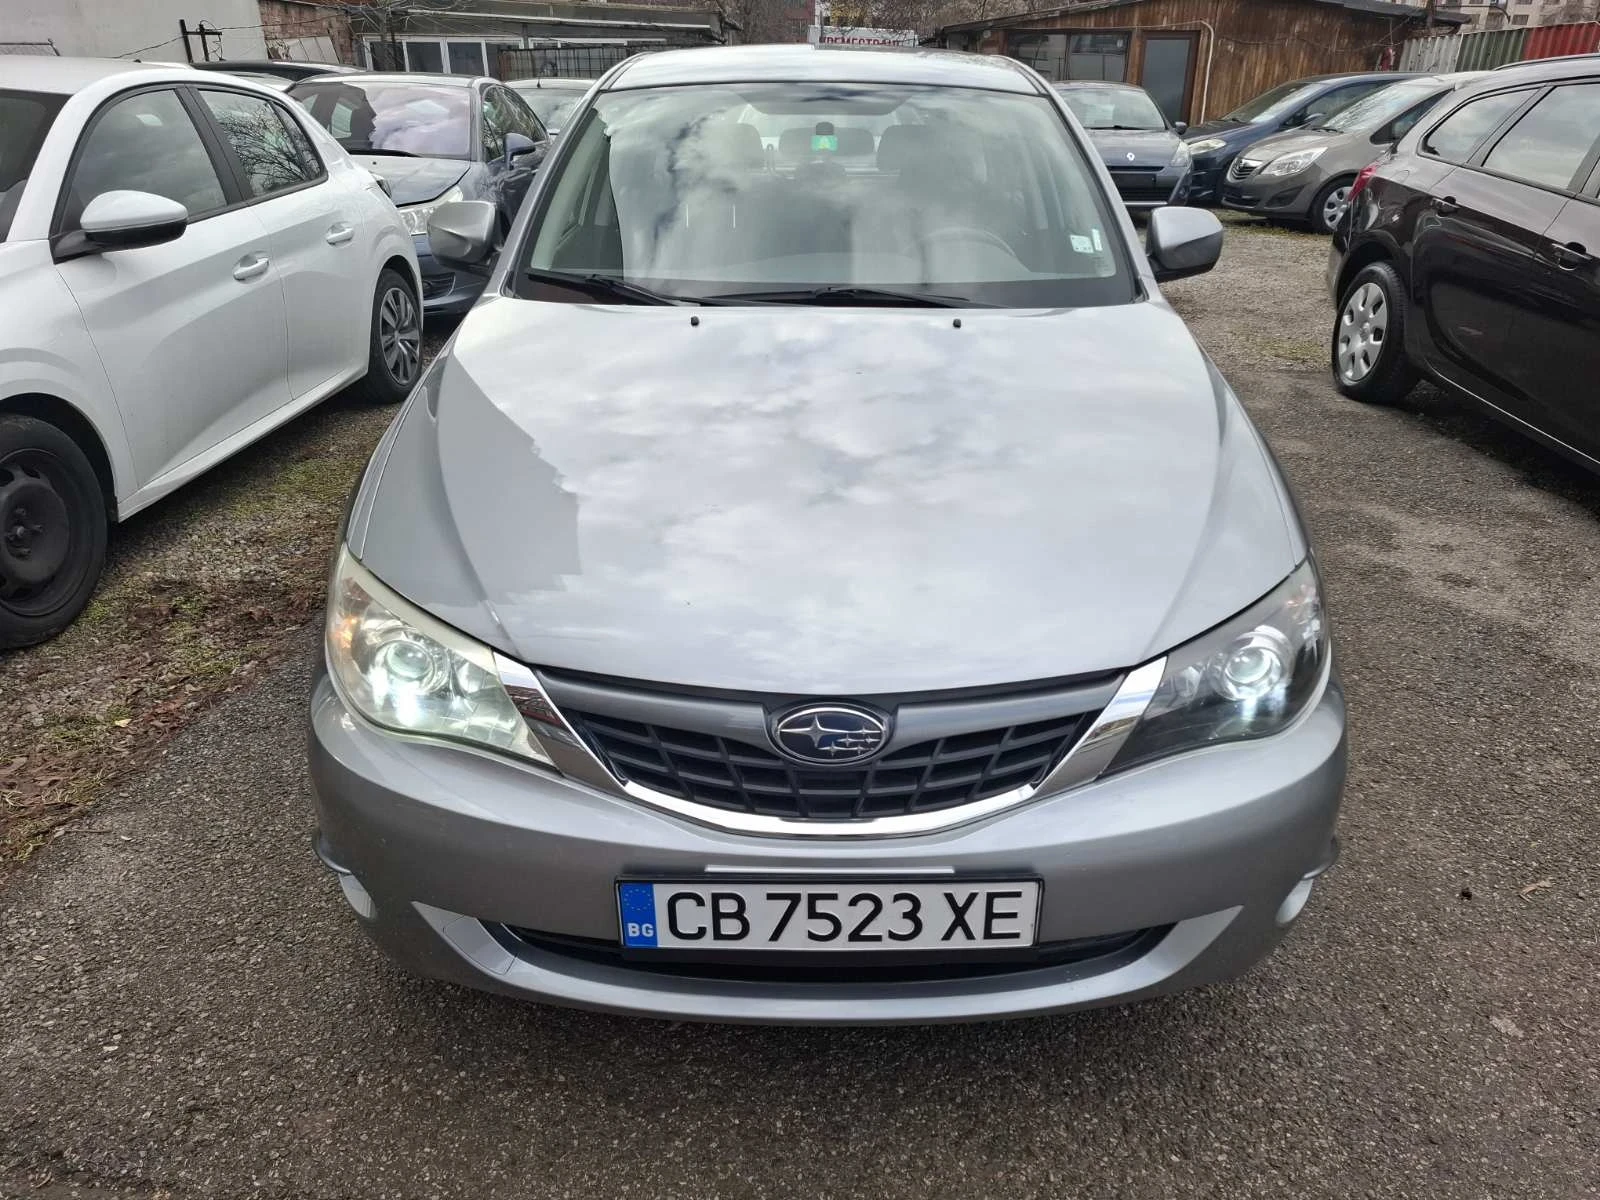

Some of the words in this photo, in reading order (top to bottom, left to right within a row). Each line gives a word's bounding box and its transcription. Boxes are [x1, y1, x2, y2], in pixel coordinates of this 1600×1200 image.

[627, 922, 655, 938] BG
[667, 891, 751, 942] CB
[765, 891, 923, 943] 7523
[940, 890, 1023, 942] XE
